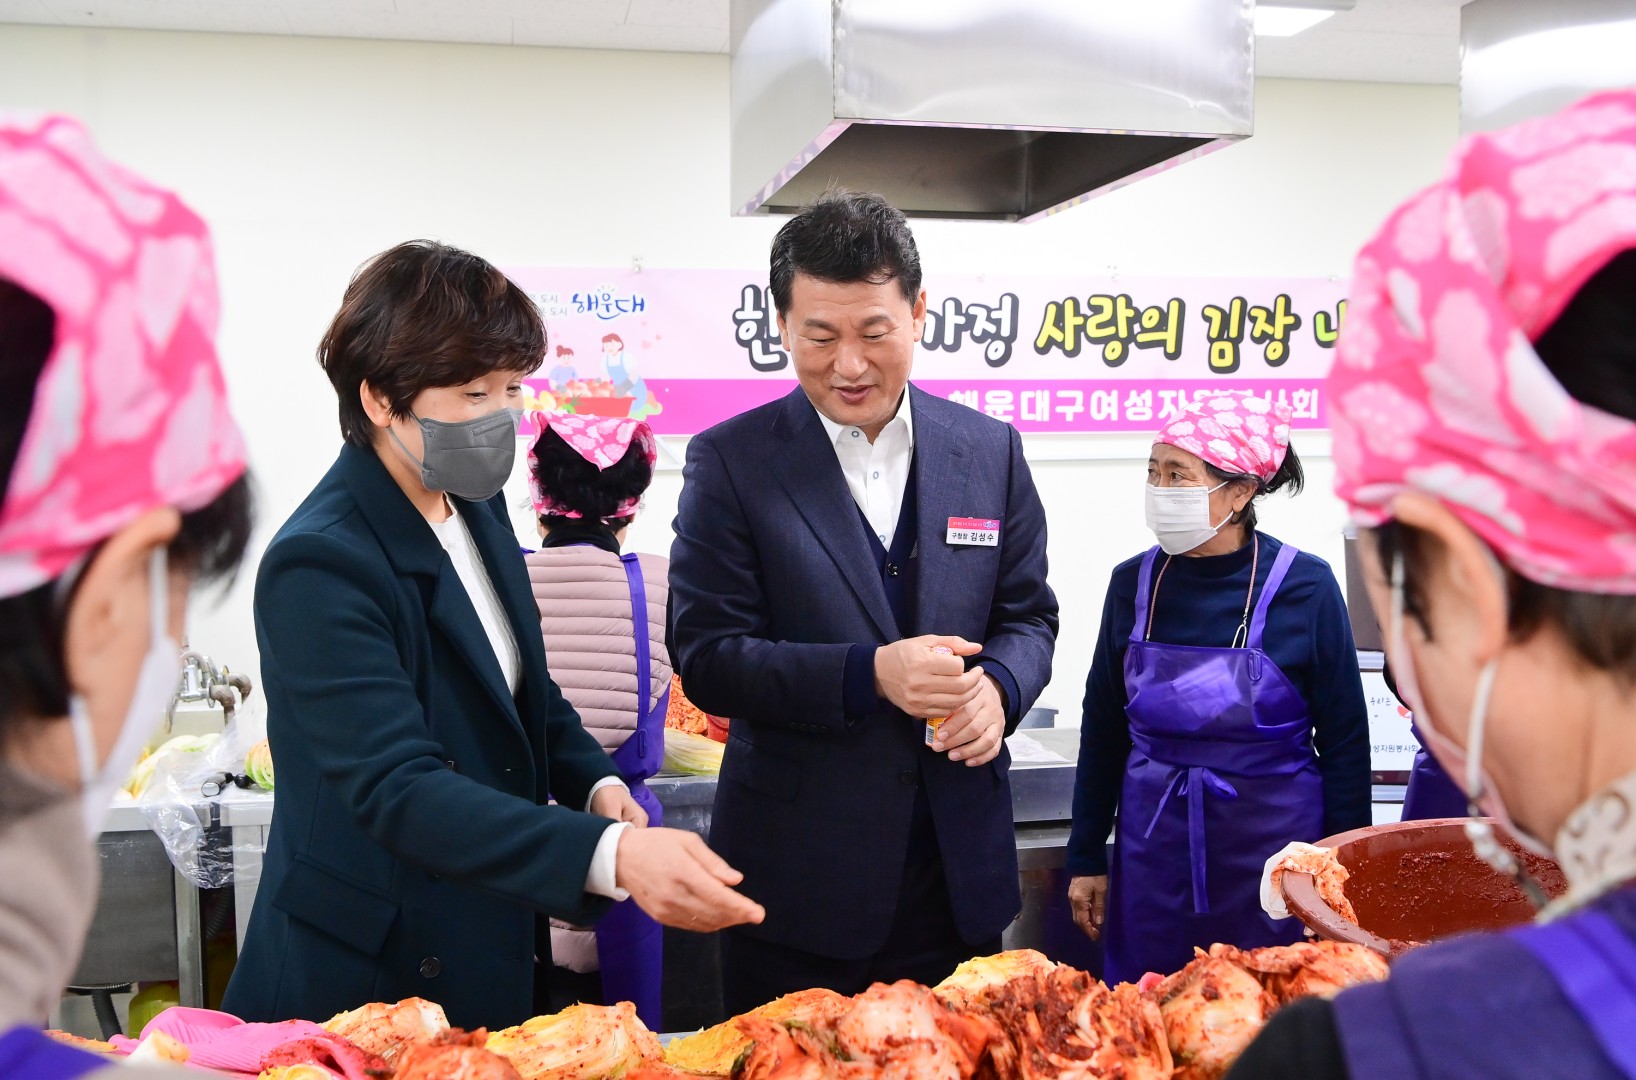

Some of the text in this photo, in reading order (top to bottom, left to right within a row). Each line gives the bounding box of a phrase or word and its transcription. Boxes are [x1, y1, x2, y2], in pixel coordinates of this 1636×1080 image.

[571, 292, 645, 320] 해운대
[1034, 293, 1186, 367] 사랑의
[1201, 294, 1301, 374] 김장
[970, 532, 994, 542] 김성수
[1370, 744, 1418, 753] 성자원봉사회
